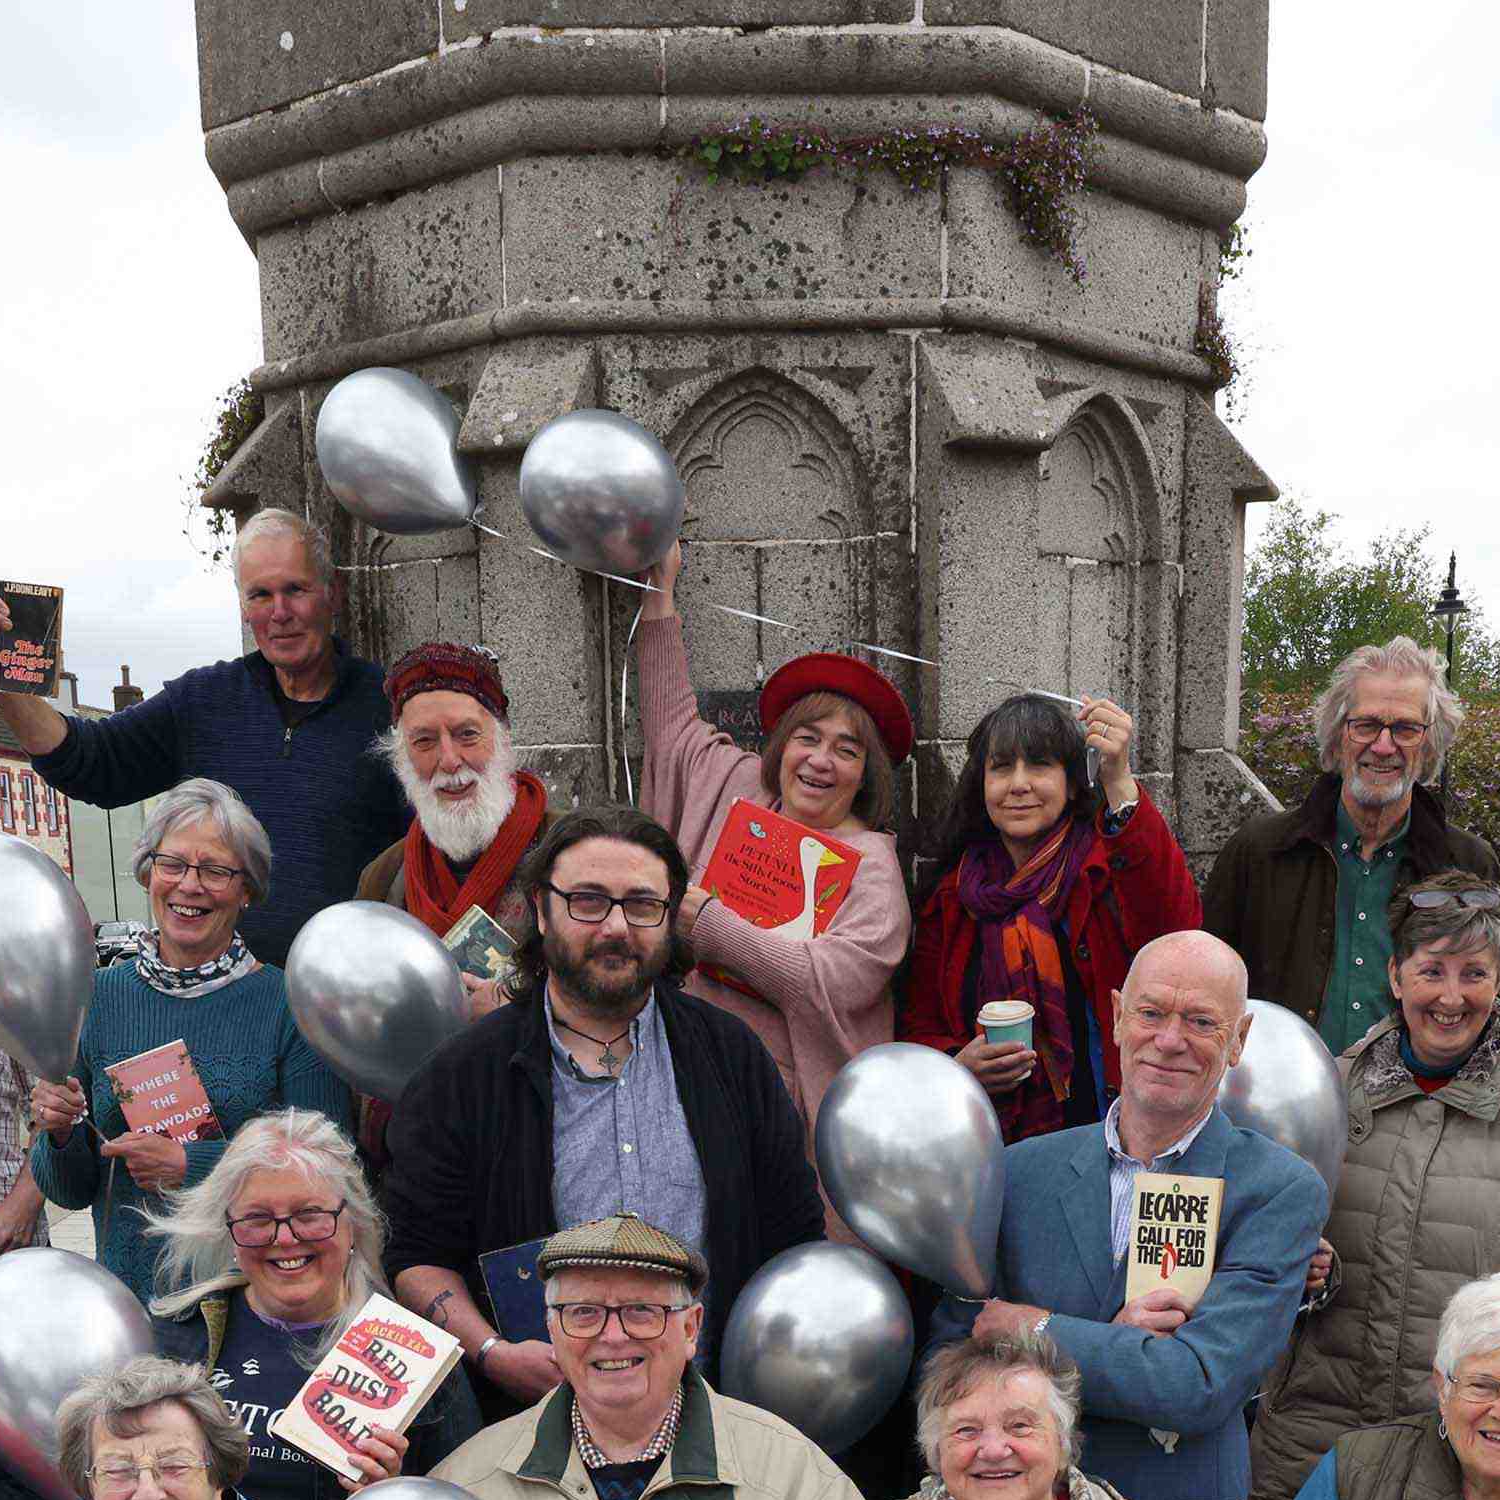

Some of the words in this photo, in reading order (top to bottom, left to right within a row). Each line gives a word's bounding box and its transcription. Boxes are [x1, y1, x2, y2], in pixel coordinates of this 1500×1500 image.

[15, 640, 44, 656] The
[0, 649, 54, 670] Ginger
[4, 666, 44, 683] Man
[740, 873, 777, 897] Stories
[131, 1070, 181, 1095] WHERE
[151, 1092, 179, 1110] THE
[1137, 1226, 1172, 1246] CALL
[1175, 1229, 1206, 1248] FOR
[1137, 1245, 1161, 1265] THE
[364, 1322, 405, 1345] JACKIE
[363, 1339, 407, 1382] RED
[329, 1364, 398, 1405] DUST
